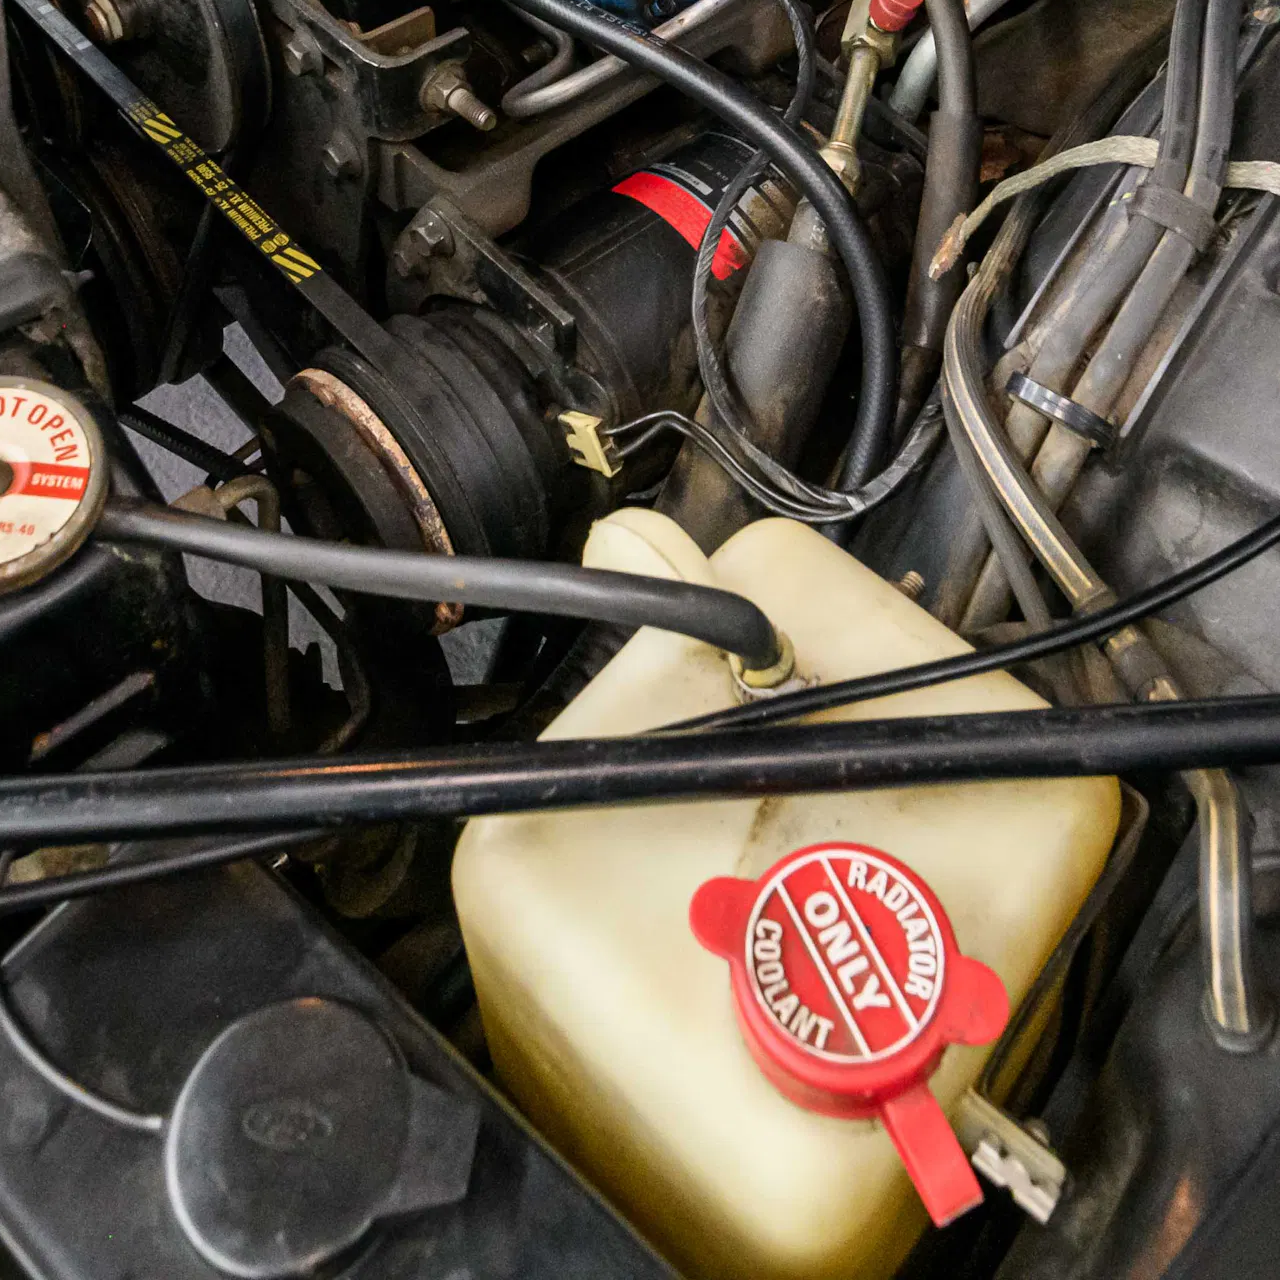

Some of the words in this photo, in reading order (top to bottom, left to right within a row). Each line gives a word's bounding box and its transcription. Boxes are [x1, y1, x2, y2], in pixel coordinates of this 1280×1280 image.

[194, 160, 229, 194] 25-9590
[226, 206, 261, 242] PREMIUM
[238, 199, 273, 236] PREMIUM
[27, 403, 81, 462] OPEN
[30, 472, 84, 491] SYSTEM
[803, 889, 891, 1012] ONLY
[846, 858, 938, 1001] RADIATOR
[753, 917, 835, 1051] COOLANT
